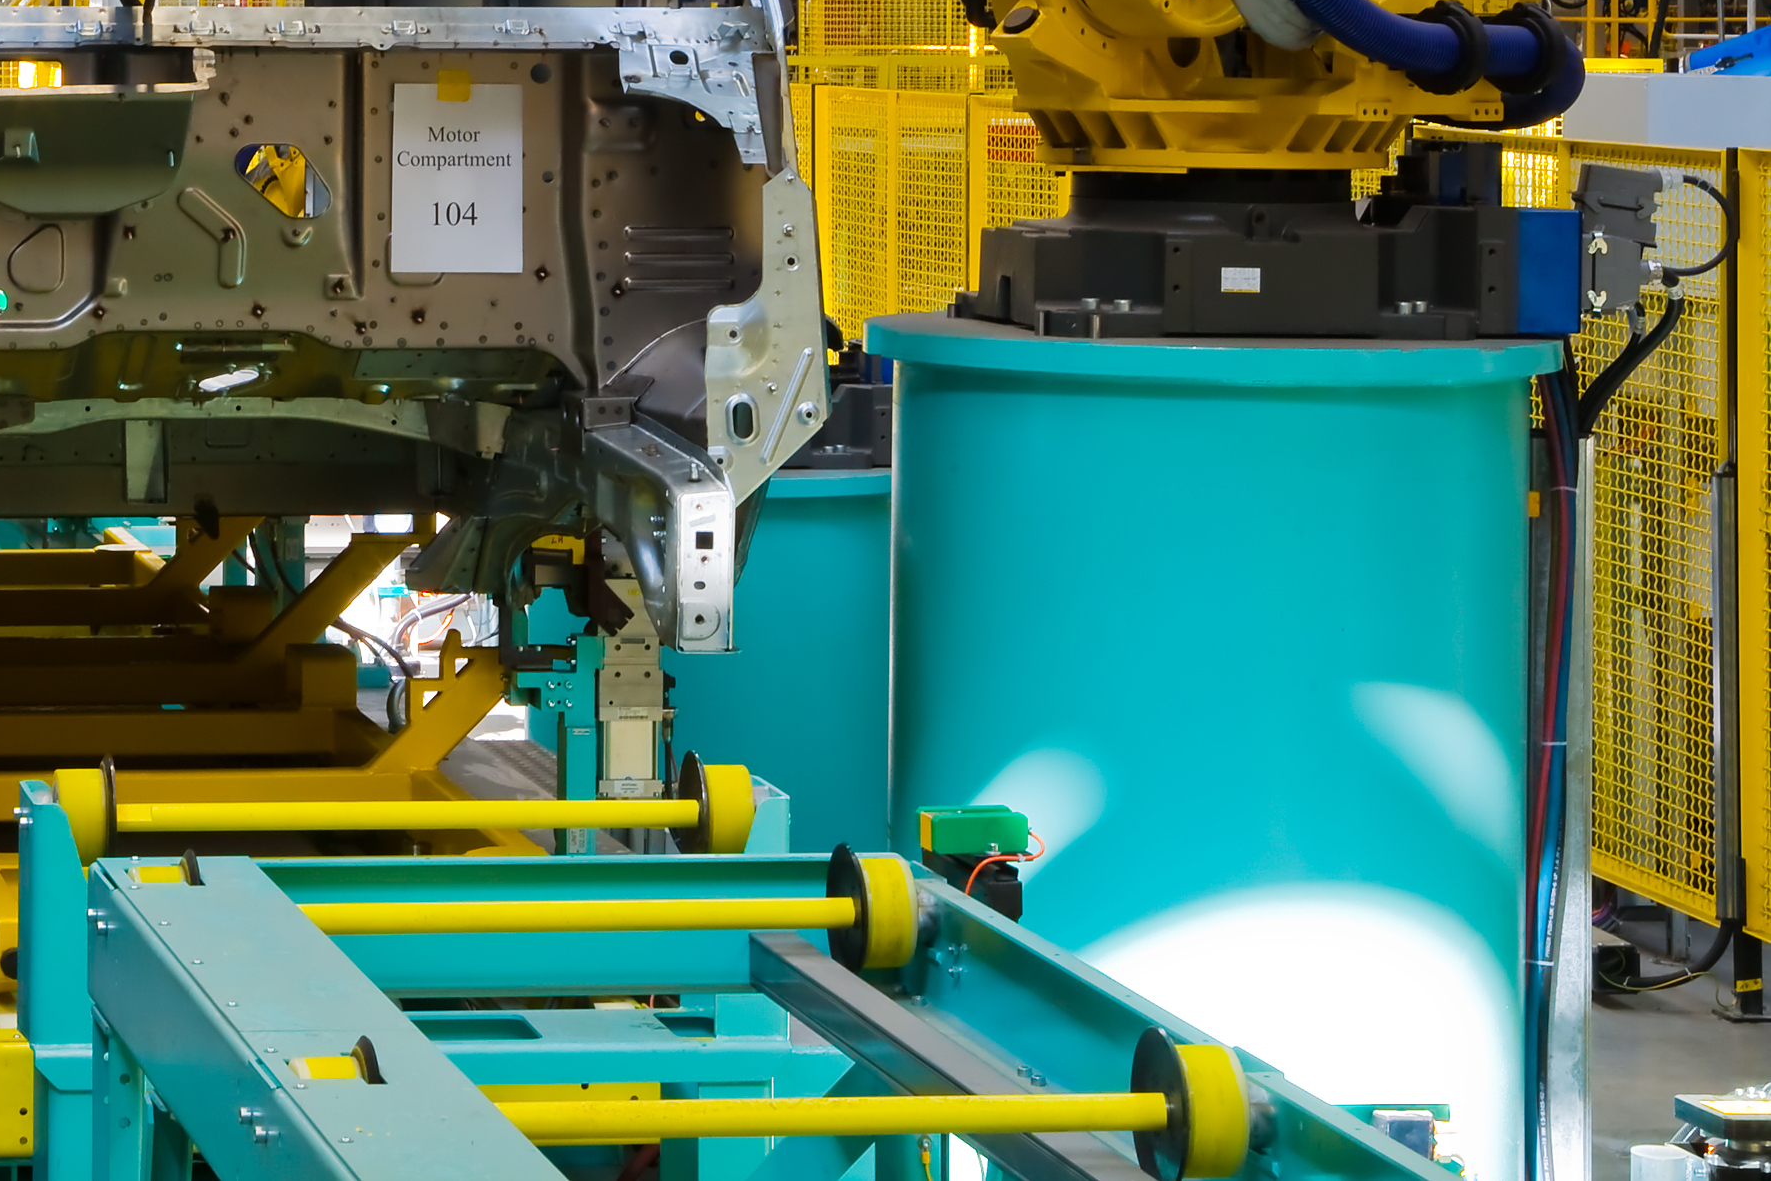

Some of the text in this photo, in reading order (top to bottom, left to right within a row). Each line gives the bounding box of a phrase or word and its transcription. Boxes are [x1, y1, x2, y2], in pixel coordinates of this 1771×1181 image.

[427, 126, 481, 143] Motor
[396, 150, 512, 171] Compartment
[431, 201, 479, 227] 104
